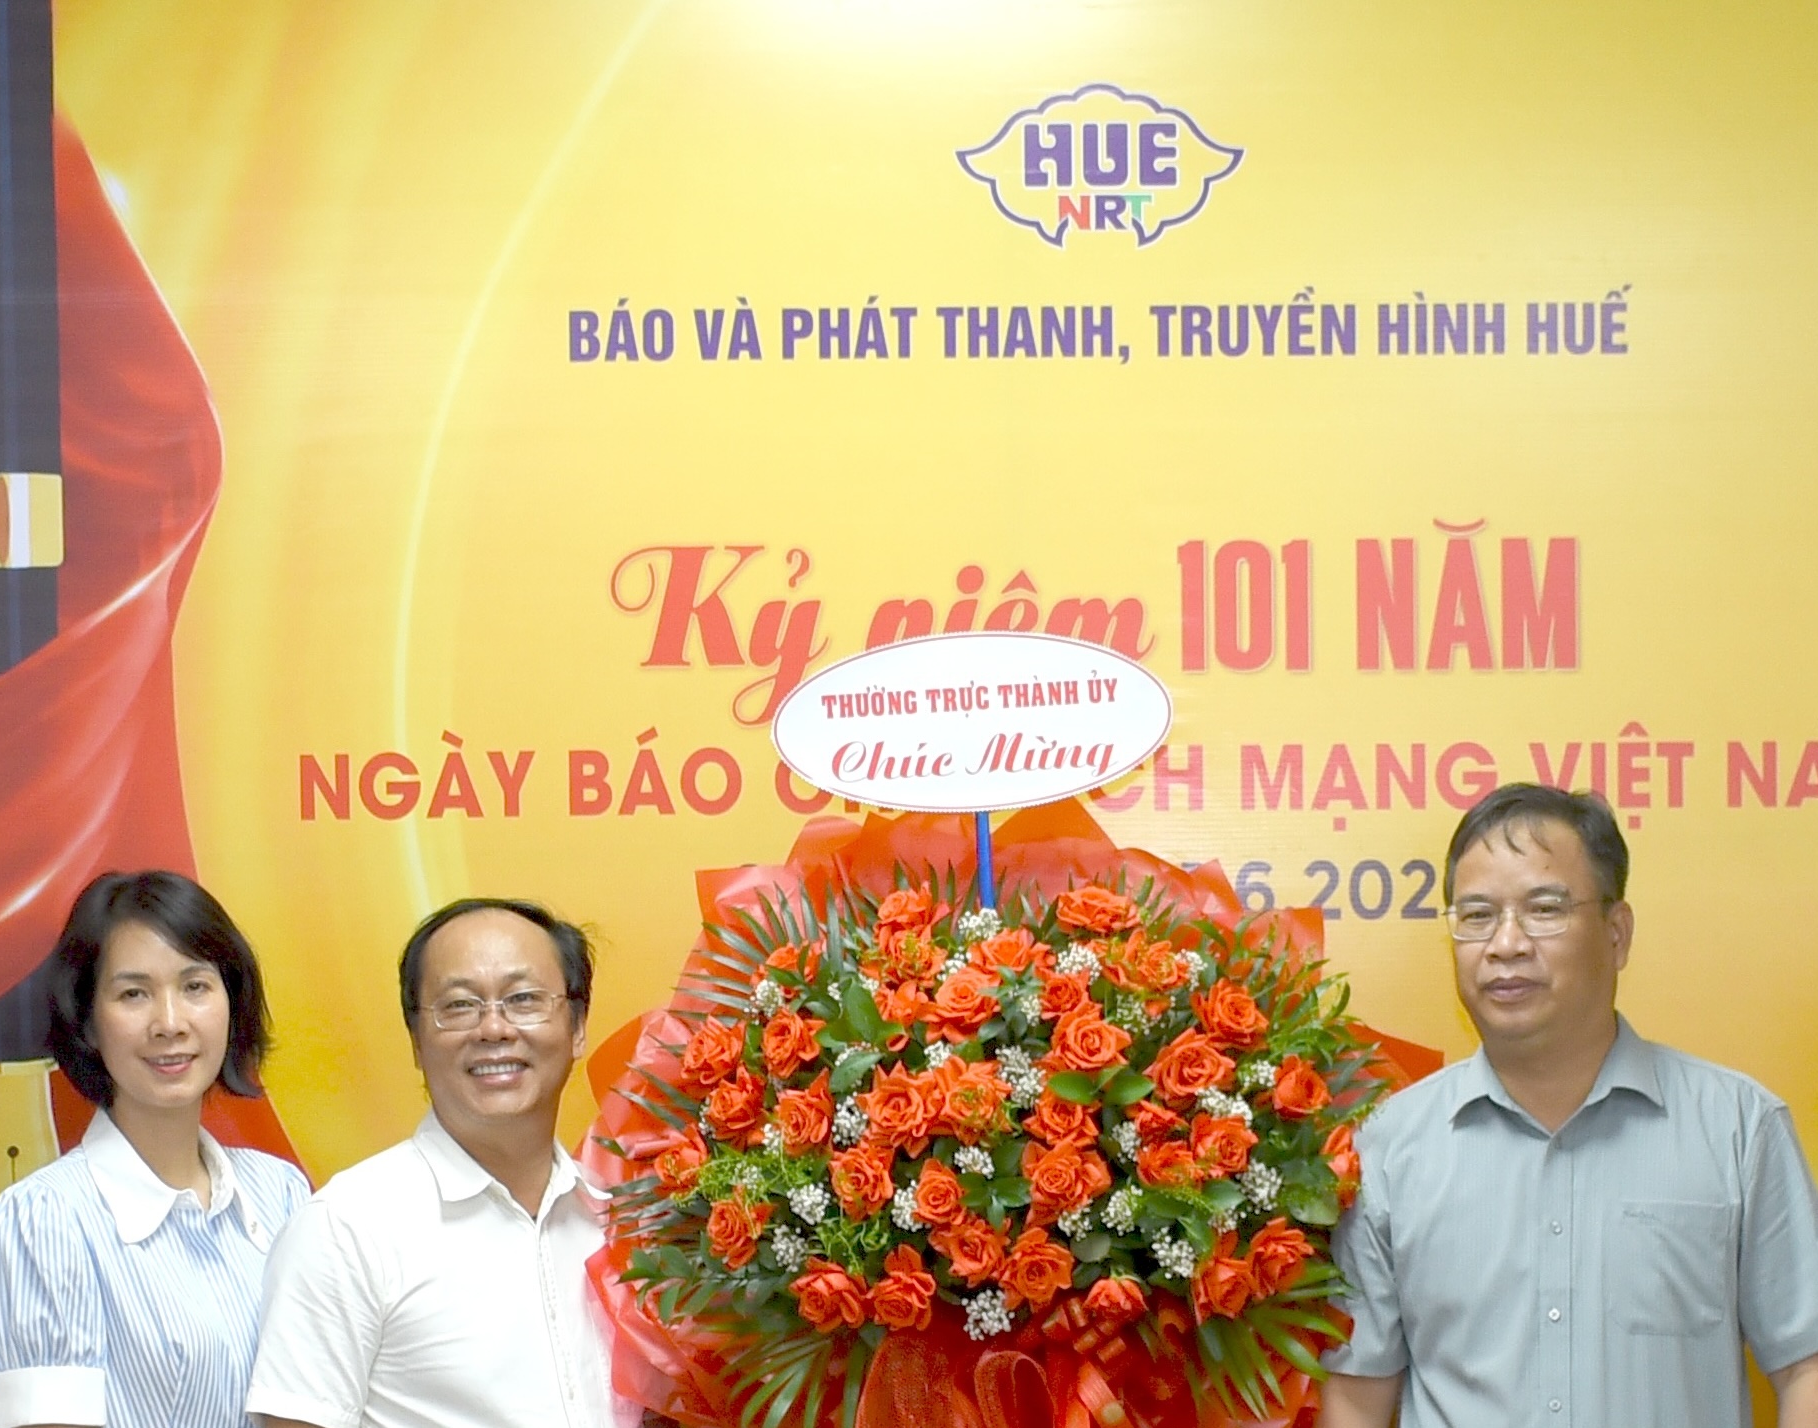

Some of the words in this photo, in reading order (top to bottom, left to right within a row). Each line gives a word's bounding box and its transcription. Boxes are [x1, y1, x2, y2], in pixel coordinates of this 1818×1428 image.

[1024, 123, 1178, 187] HUE
[1057, 195, 1153, 231] NRT
[568, 297, 674, 363] BÁO
[693, 297, 762, 362] VÀ
[781, 295, 918, 361] PHÁT
[936, 305, 1131, 364] THANH,
[1150, 286, 1356, 357] TRUYỀN
[1377, 291, 1506, 356] HÌNH
[1526, 284, 1632, 355] HUẾ
[611, 546, 828, 726] Kỷ
[1177, 539, 1309, 671] 101
[1356, 517, 1577, 670] NĂM
[821, 685, 917, 719] THƯỜNG
[925, 680, 990, 718] TRỰC
[997, 675, 1079, 709] THÀNH
[1087, 669, 1118, 703] ỦY
[299, 729, 535, 820] NGÀY
[568, 726, 743, 817] BÁO
[1240, 742, 1498, 832] MẠNG
[1528, 721, 1694, 830] VIỆT
[831, 741, 956, 783] Chúc
[965, 732, 1118, 777] Mừng
